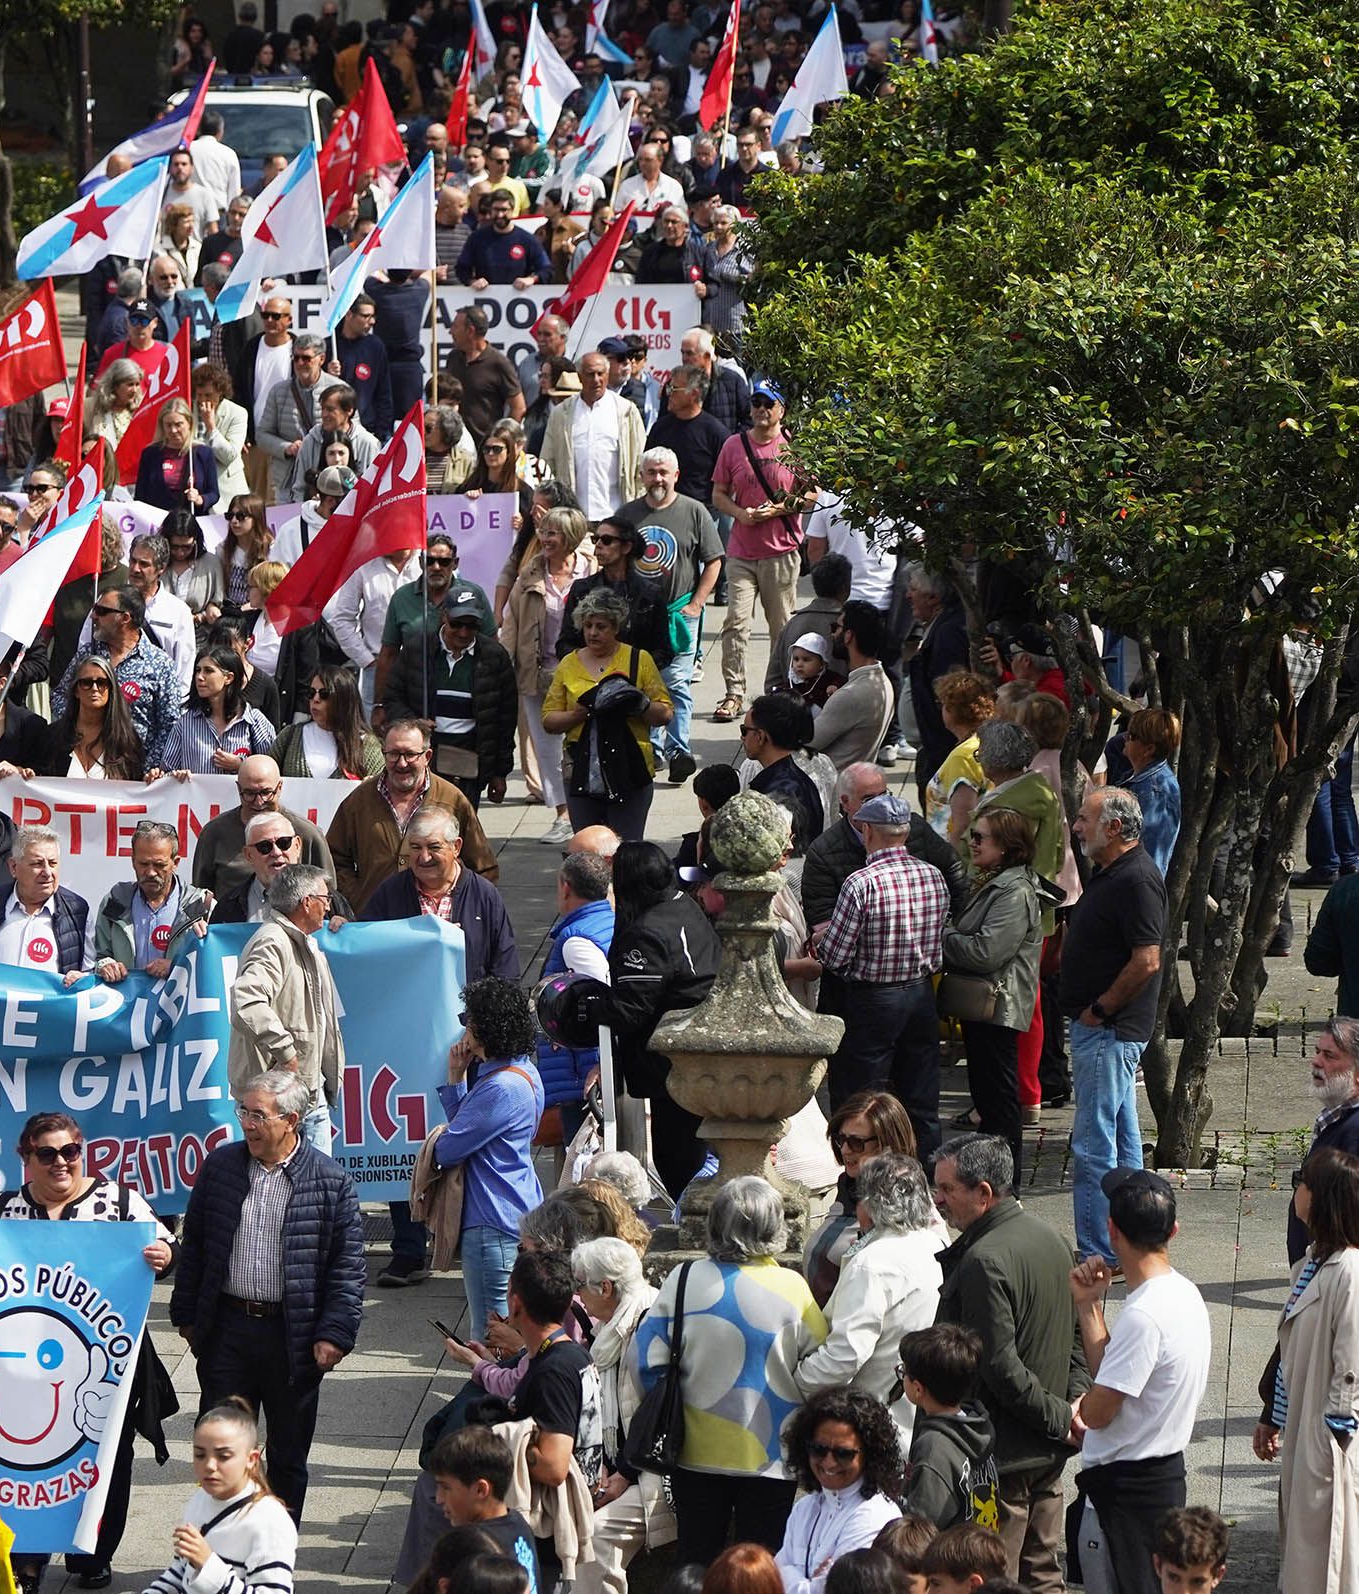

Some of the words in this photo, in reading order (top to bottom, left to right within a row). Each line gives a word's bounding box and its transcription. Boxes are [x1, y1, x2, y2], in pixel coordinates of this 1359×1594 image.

[615, 297, 670, 330] CIG
[74, 951, 302, 1052] PÚBLI
[59, 1039, 235, 1119] GALIZ
[332, 1063, 429, 1146] IG
[25, 1125, 232, 1196] REITOS
[350, 1157, 363, 1168] DE
[367, 1154, 416, 1168] XUBILAD
[351, 1169, 412, 1183] SIONISTAS
